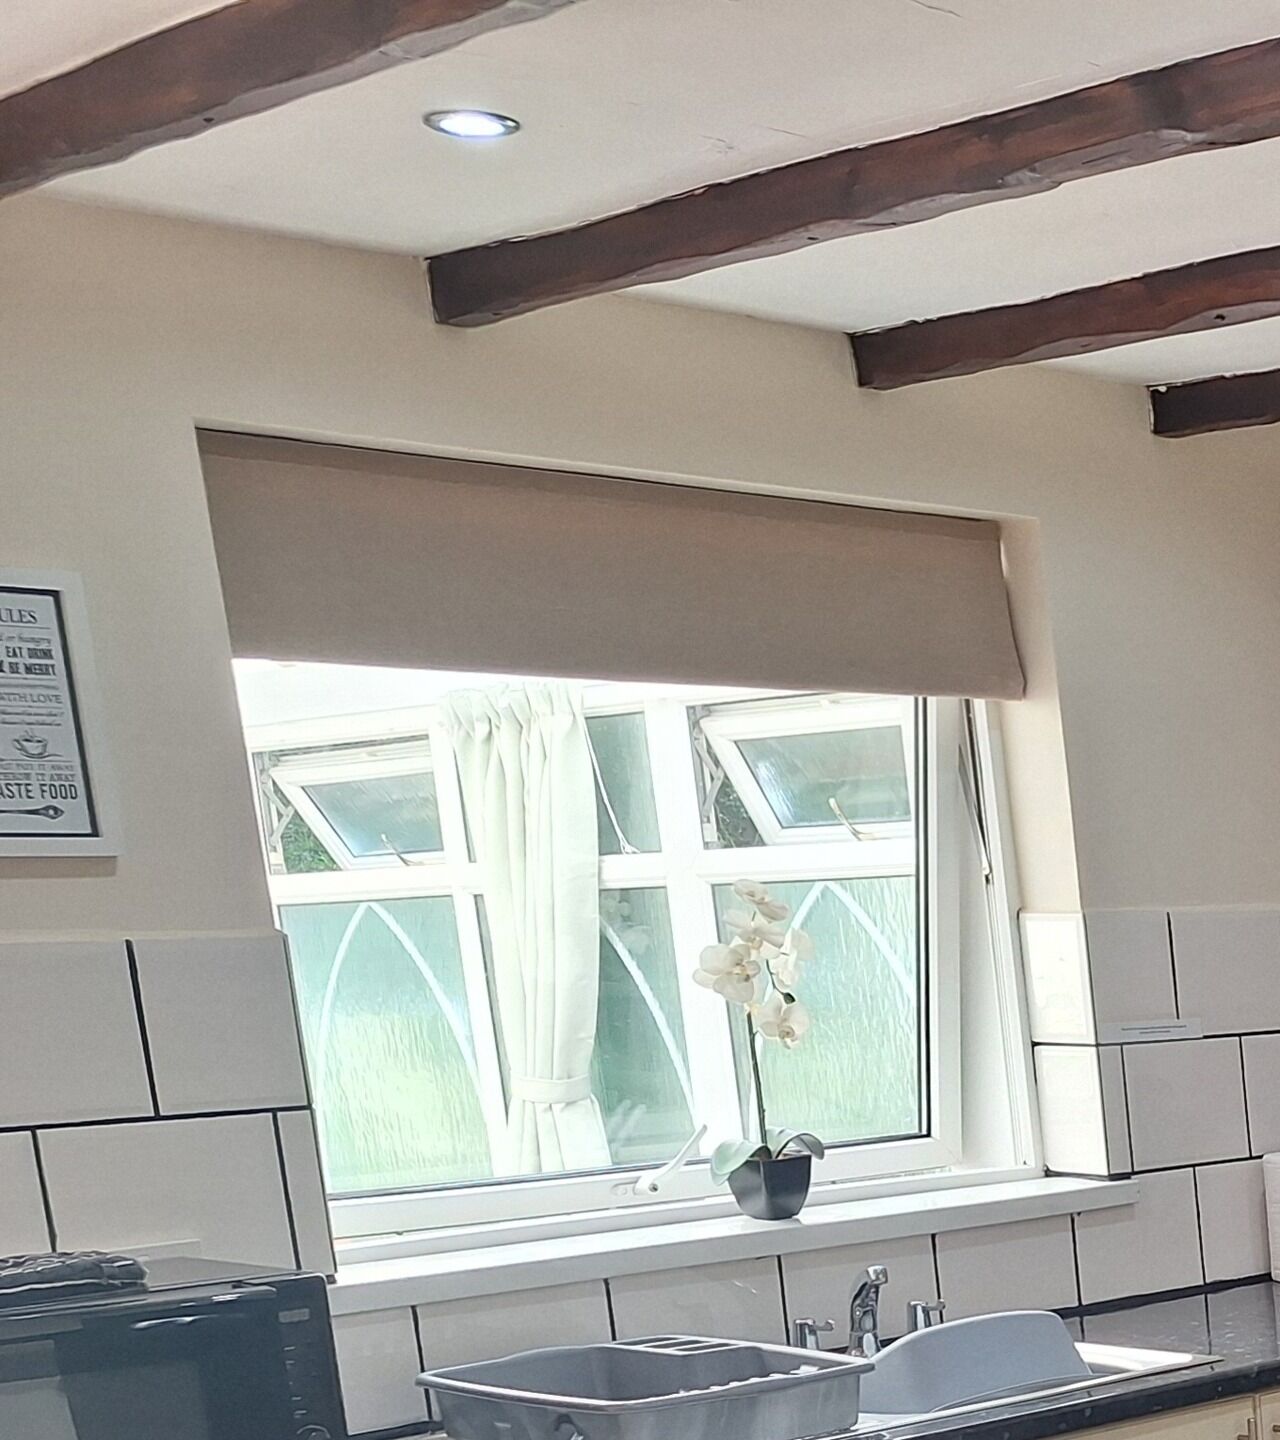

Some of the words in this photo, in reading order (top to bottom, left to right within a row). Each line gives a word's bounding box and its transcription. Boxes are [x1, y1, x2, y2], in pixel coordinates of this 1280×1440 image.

[0, 607, 38, 624] ULES
[5, 645, 23, 658] EAT
[30, 693, 63, 704] LOVE
[0, 782, 35, 800] ASTE
[39, 783, 78, 800] FOOD
